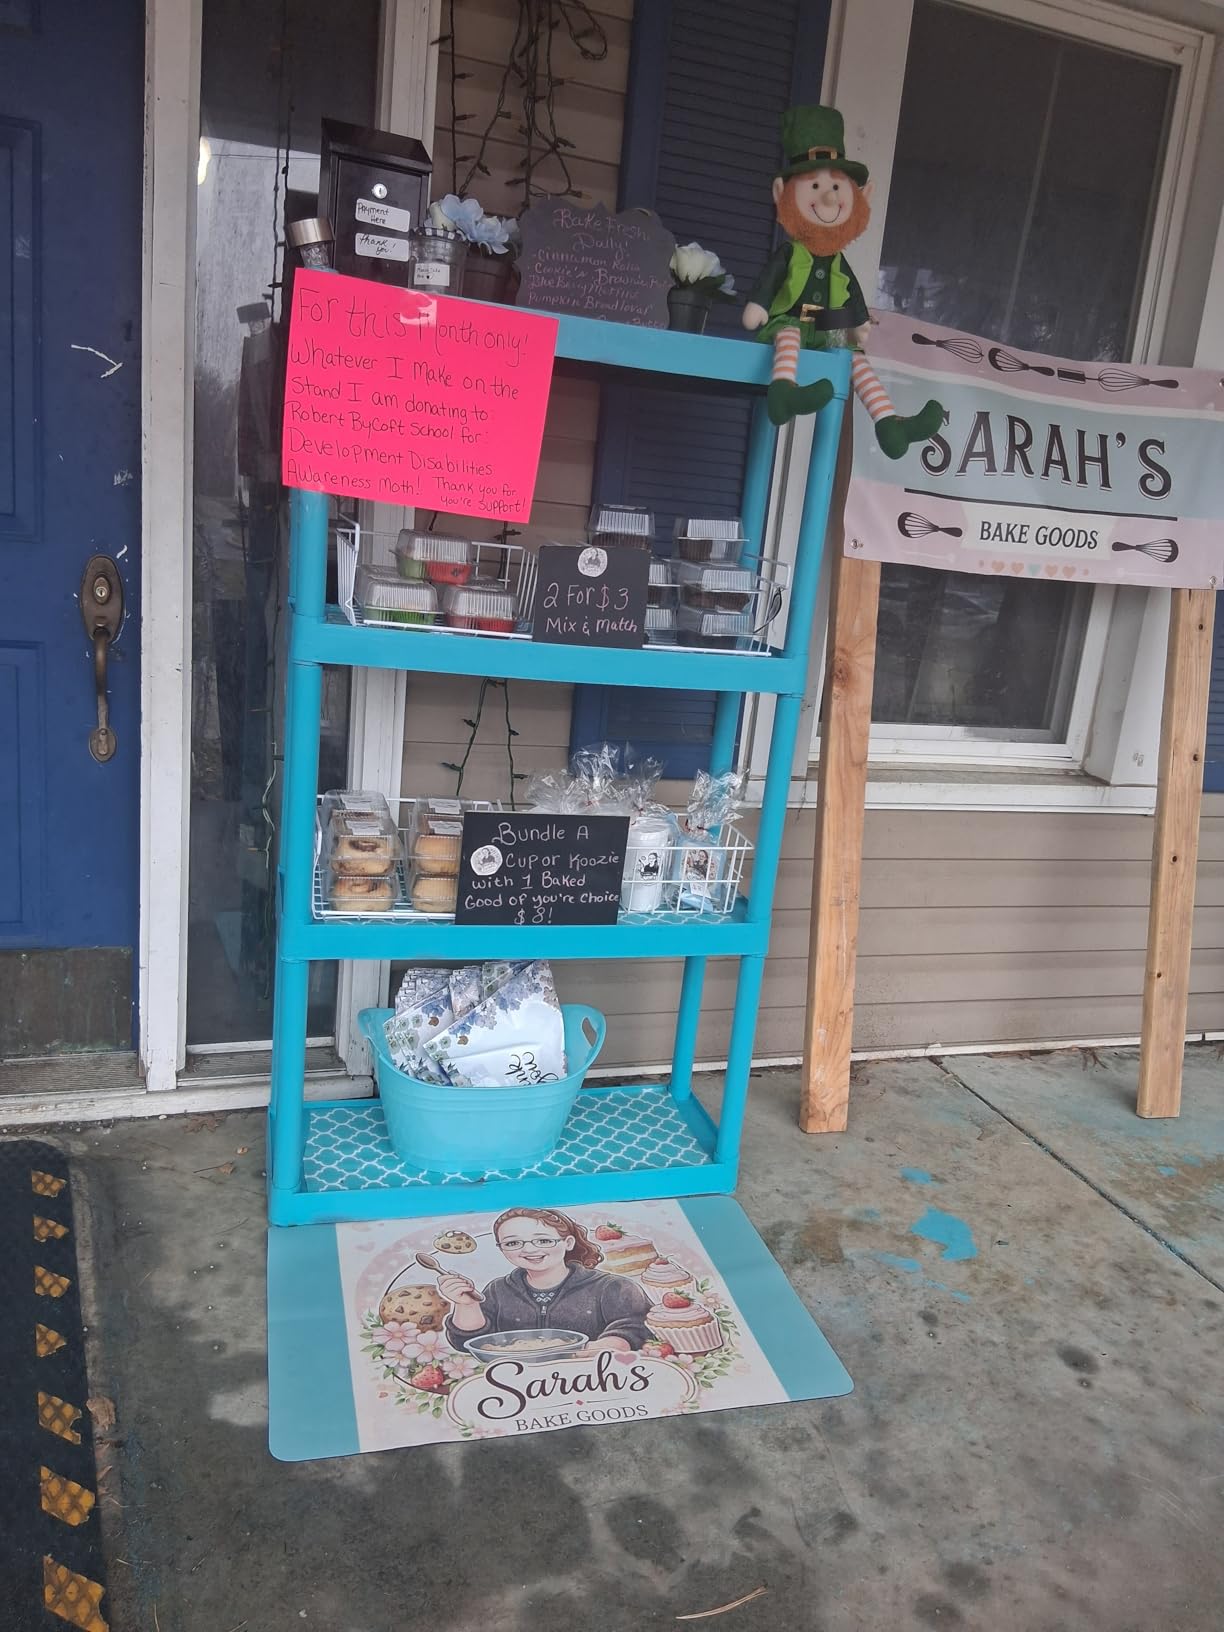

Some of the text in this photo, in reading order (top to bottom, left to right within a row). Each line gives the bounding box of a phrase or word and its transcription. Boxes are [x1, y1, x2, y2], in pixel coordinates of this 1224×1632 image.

[300, 287, 339, 322] For
[346, 295, 407, 338] this
[484, 332, 529, 367] only!
[291, 337, 519, 400] Whatever I Make on the
[284, 401, 345, 426] Robert
[291, 376, 489, 425] Stand I am donating to
[287, 427, 493, 476] Development Disabilities
[920, 409, 1173, 500] SARAH'S
[432, 476, 517, 500] Thank you for
[979, 520, 1099, 549] BAKE GOODS
[543, 582, 559, 608] 2
[567, 584, 595, 606] For
[546, 616, 577, 634] Mix
[491, 822, 589, 845] Bundle A
[505, 853, 539, 869] Cup
[541, 854, 561, 866] or
[569, 851, 620, 871] Koozie
[472, 871, 586, 890] with 1 Baked
[464, 894, 502, 909] Good
[508, 893, 527, 905] of
[532, 893, 575, 909] you're
[477, 1350, 654, 1420] Sarahs
[516, 1404, 649, 1431] BAKE GOODS
